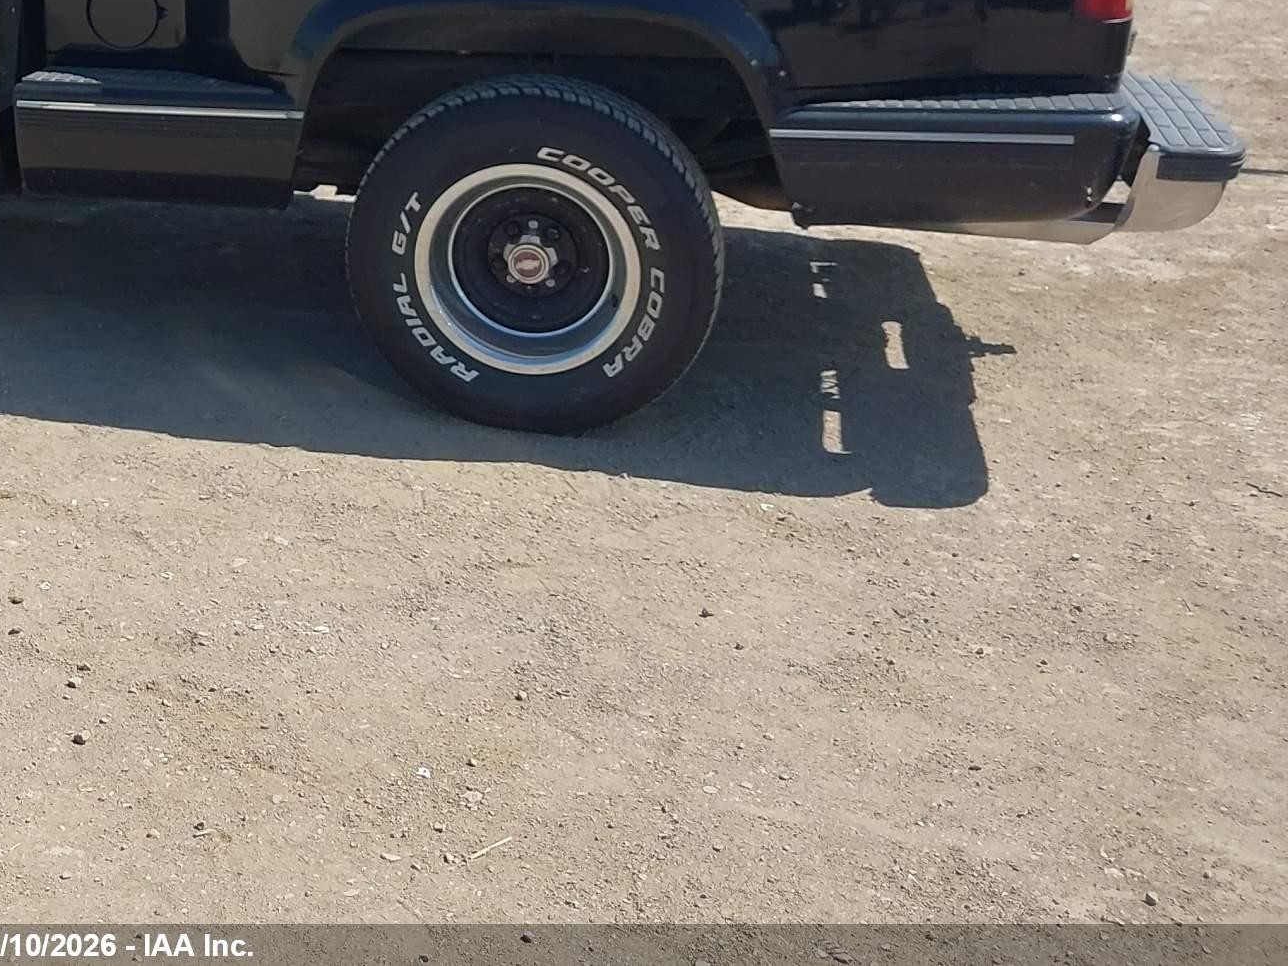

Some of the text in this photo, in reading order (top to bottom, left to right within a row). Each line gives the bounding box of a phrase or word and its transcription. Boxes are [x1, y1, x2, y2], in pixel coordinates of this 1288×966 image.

[392, 192, 480, 382] RADIAL G/T
[537, 146, 665, 377] COOPER COBRA
